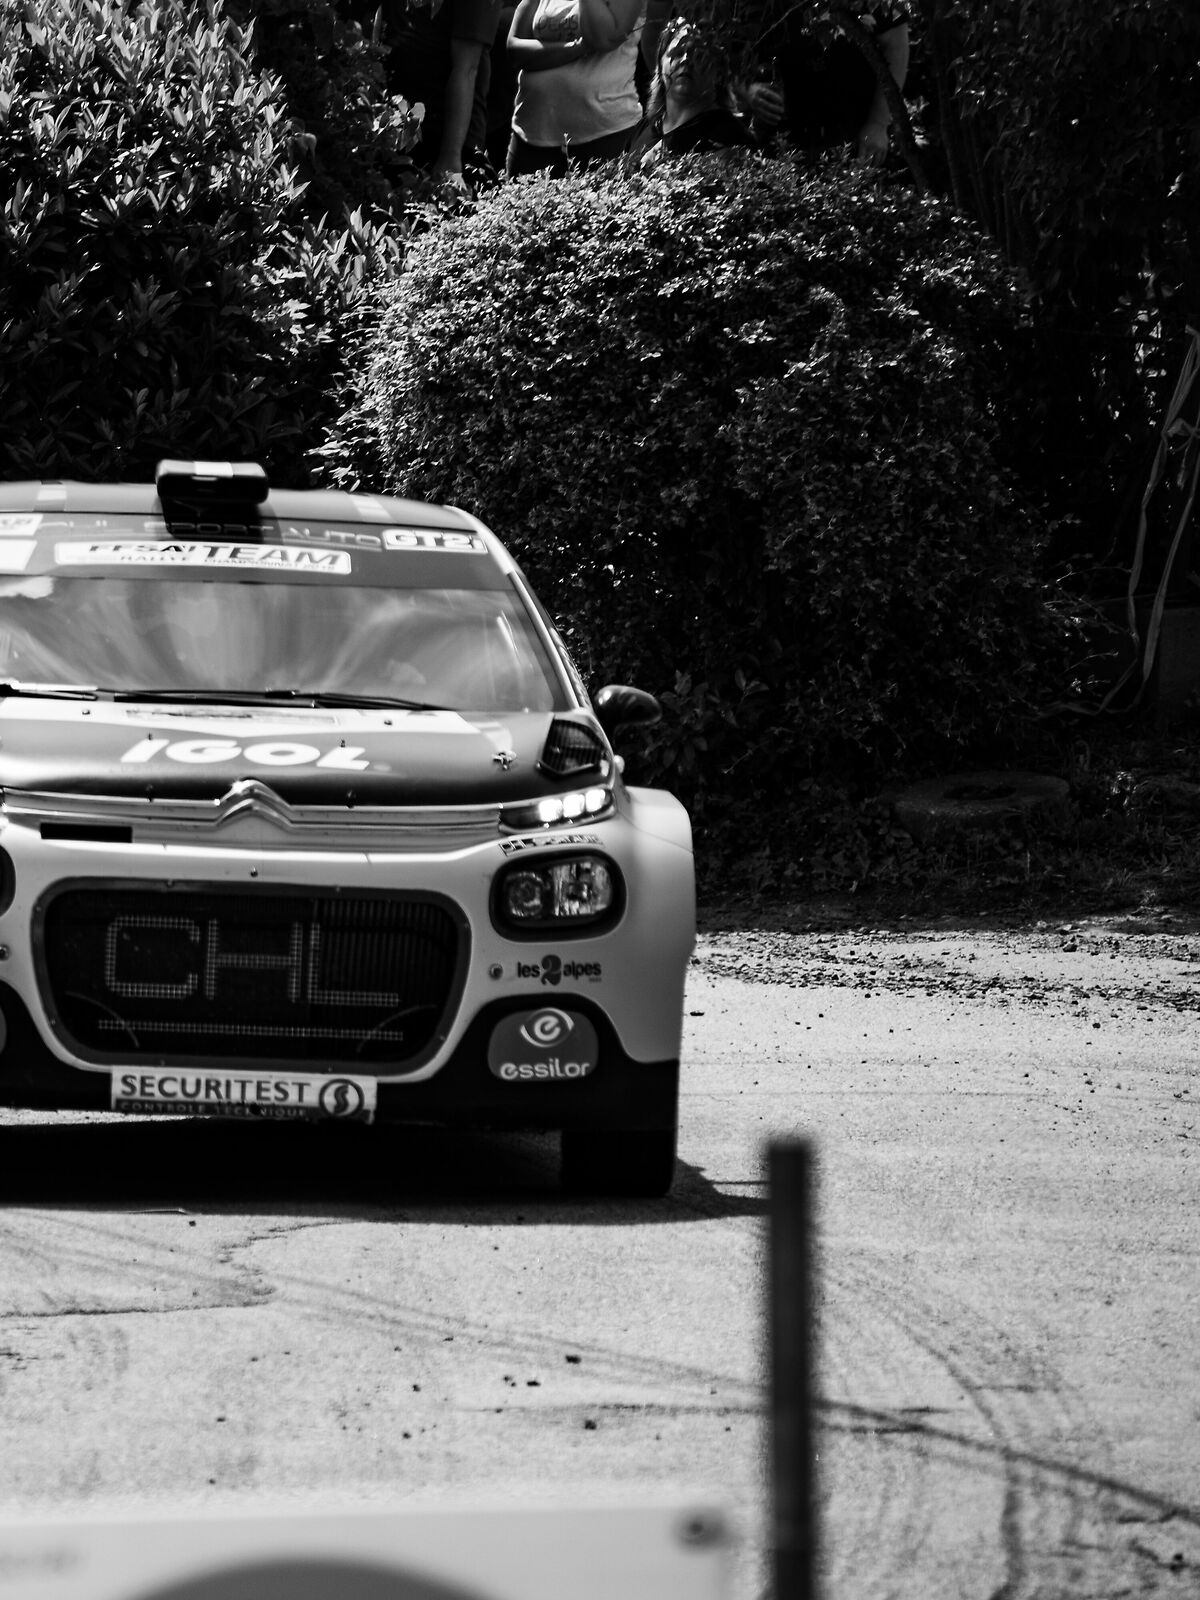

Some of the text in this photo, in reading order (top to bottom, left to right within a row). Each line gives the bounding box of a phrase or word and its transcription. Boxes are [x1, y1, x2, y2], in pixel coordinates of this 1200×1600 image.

[284, 527, 381, 546] AUTO
[203, 545, 340, 566] TEAM
[119, 738, 370, 771] IGOL
[104, 914, 401, 1008] CHL
[517, 954, 602, 986] les 2 alpes
[499, 1057, 591, 1081] essilor
[120, 1074, 311, 1104] SECURITEST
[214, 1104, 308, 1119] TECNIQUE
